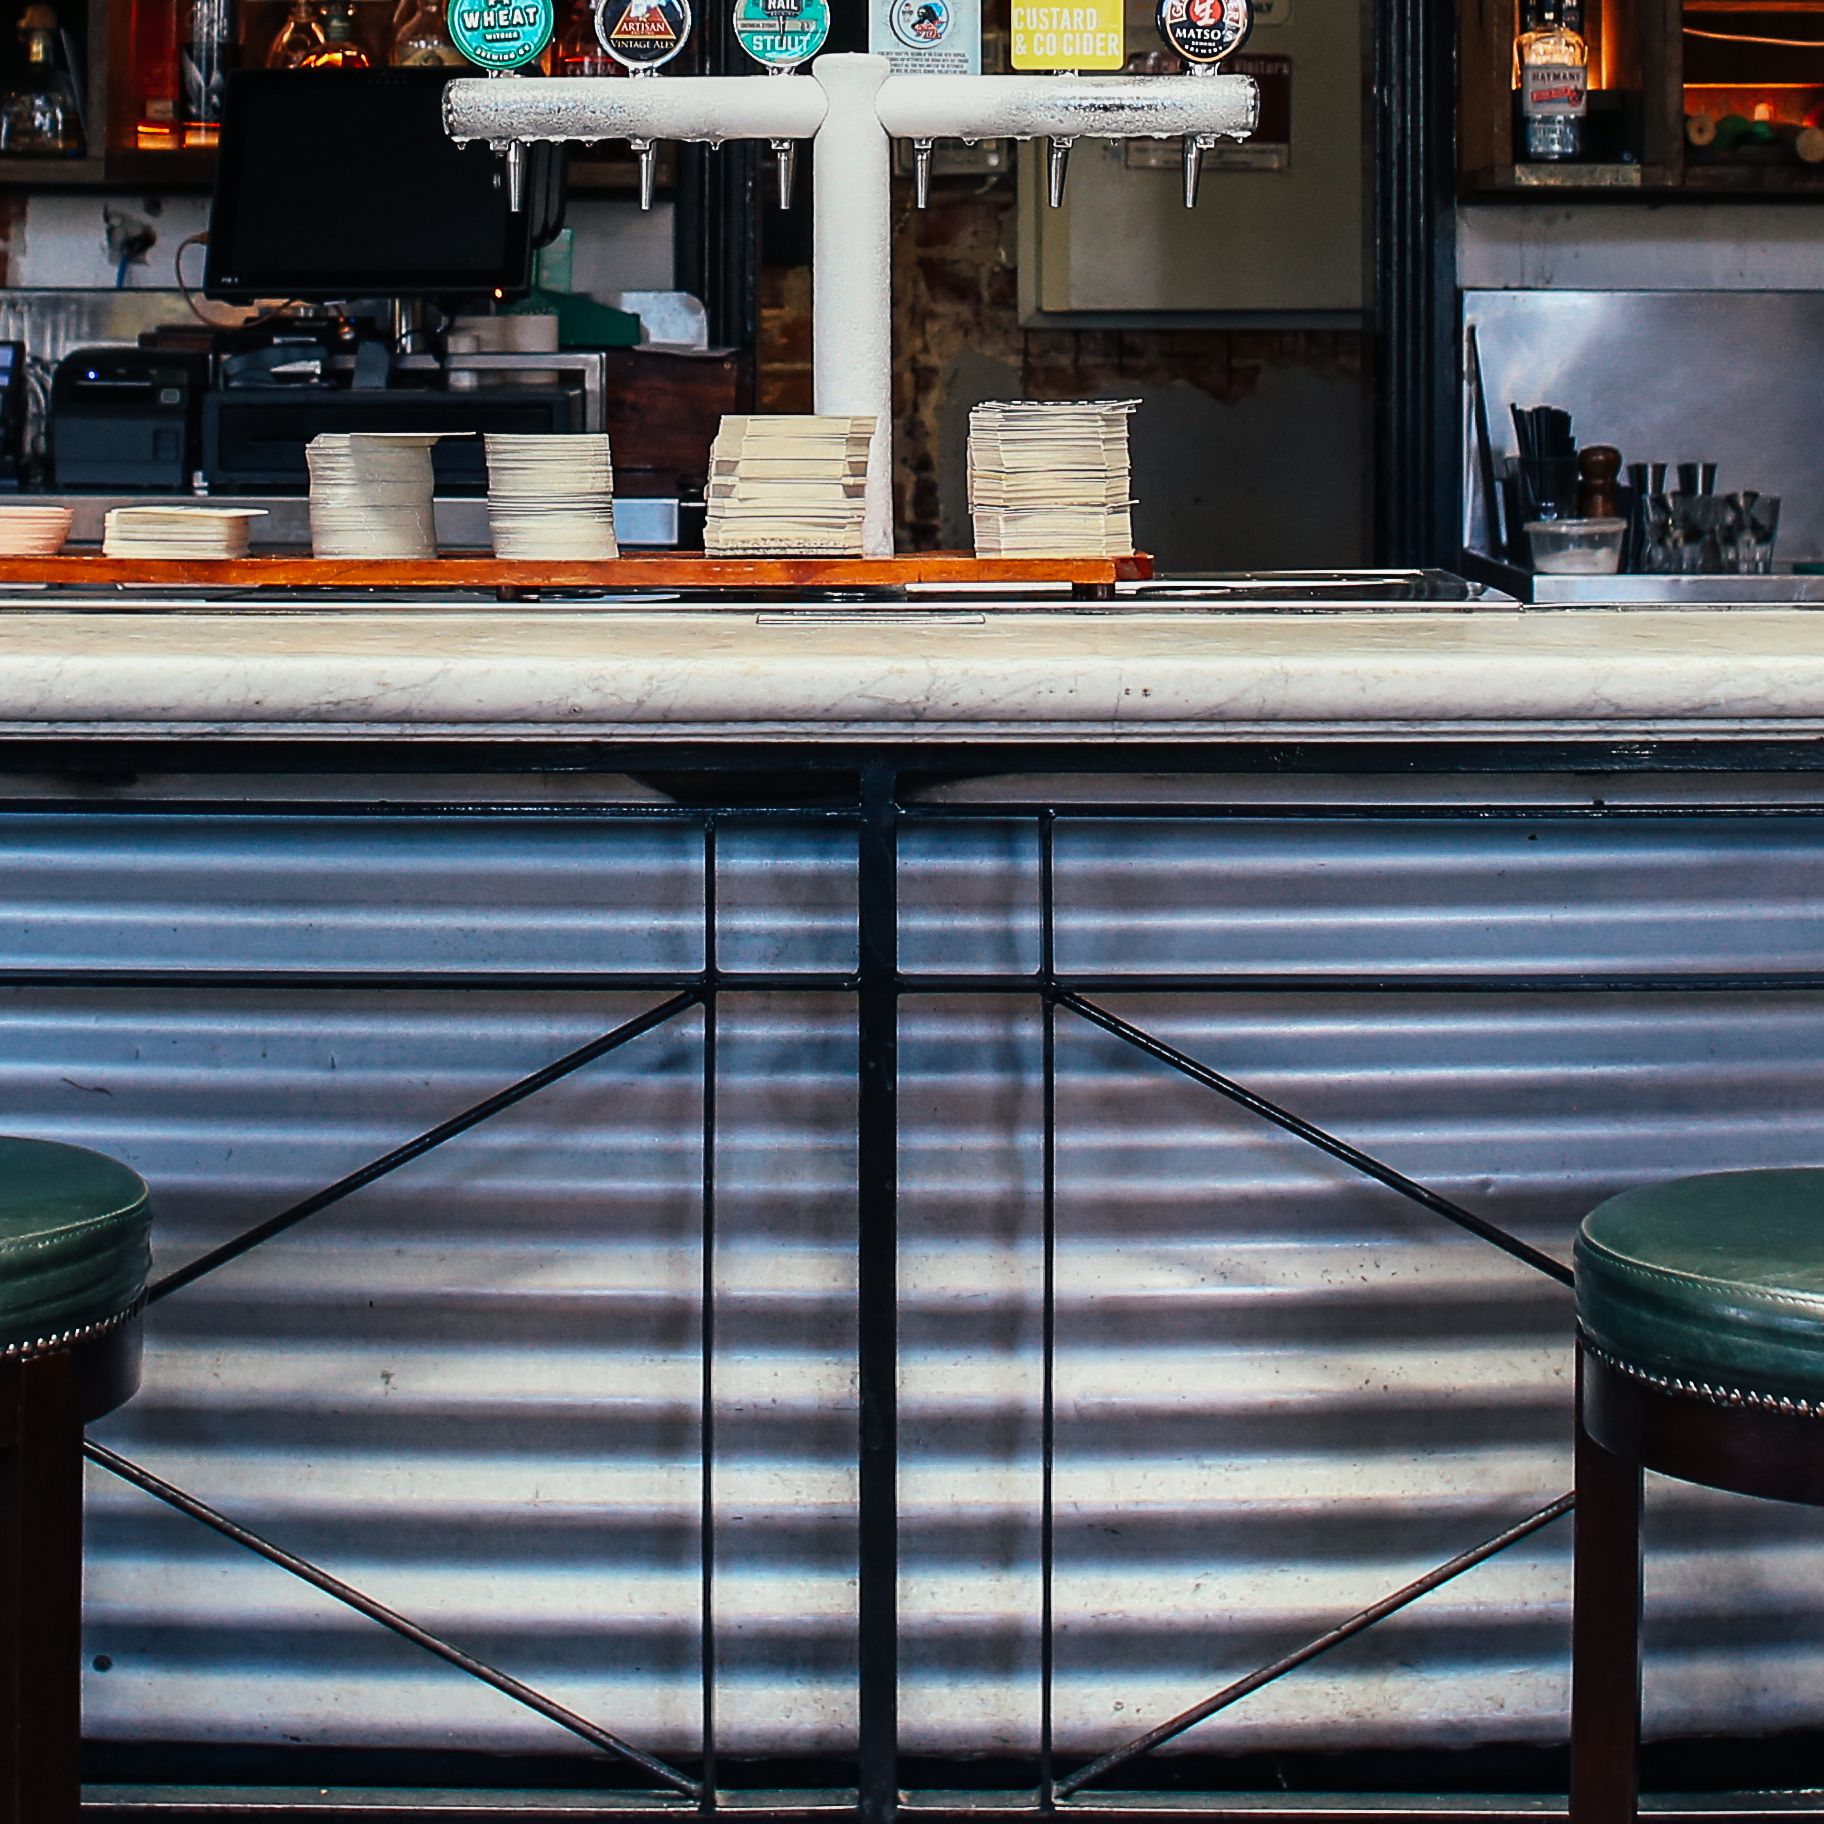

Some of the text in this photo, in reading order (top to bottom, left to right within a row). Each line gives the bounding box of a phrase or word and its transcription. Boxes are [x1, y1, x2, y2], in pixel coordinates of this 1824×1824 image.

[463, 7, 537, 29] WHEAT
[1014, 7, 1099, 31] CUSTARD
[621, 22, 666, 32] ARTISAN
[1175, 27, 1235, 43] MATSO'S
[610, 39, 675, 49] VINTAGE ALES
[752, 35, 811, 51] STOUT
[1014, 32, 1120, 56] & CO CIDER
